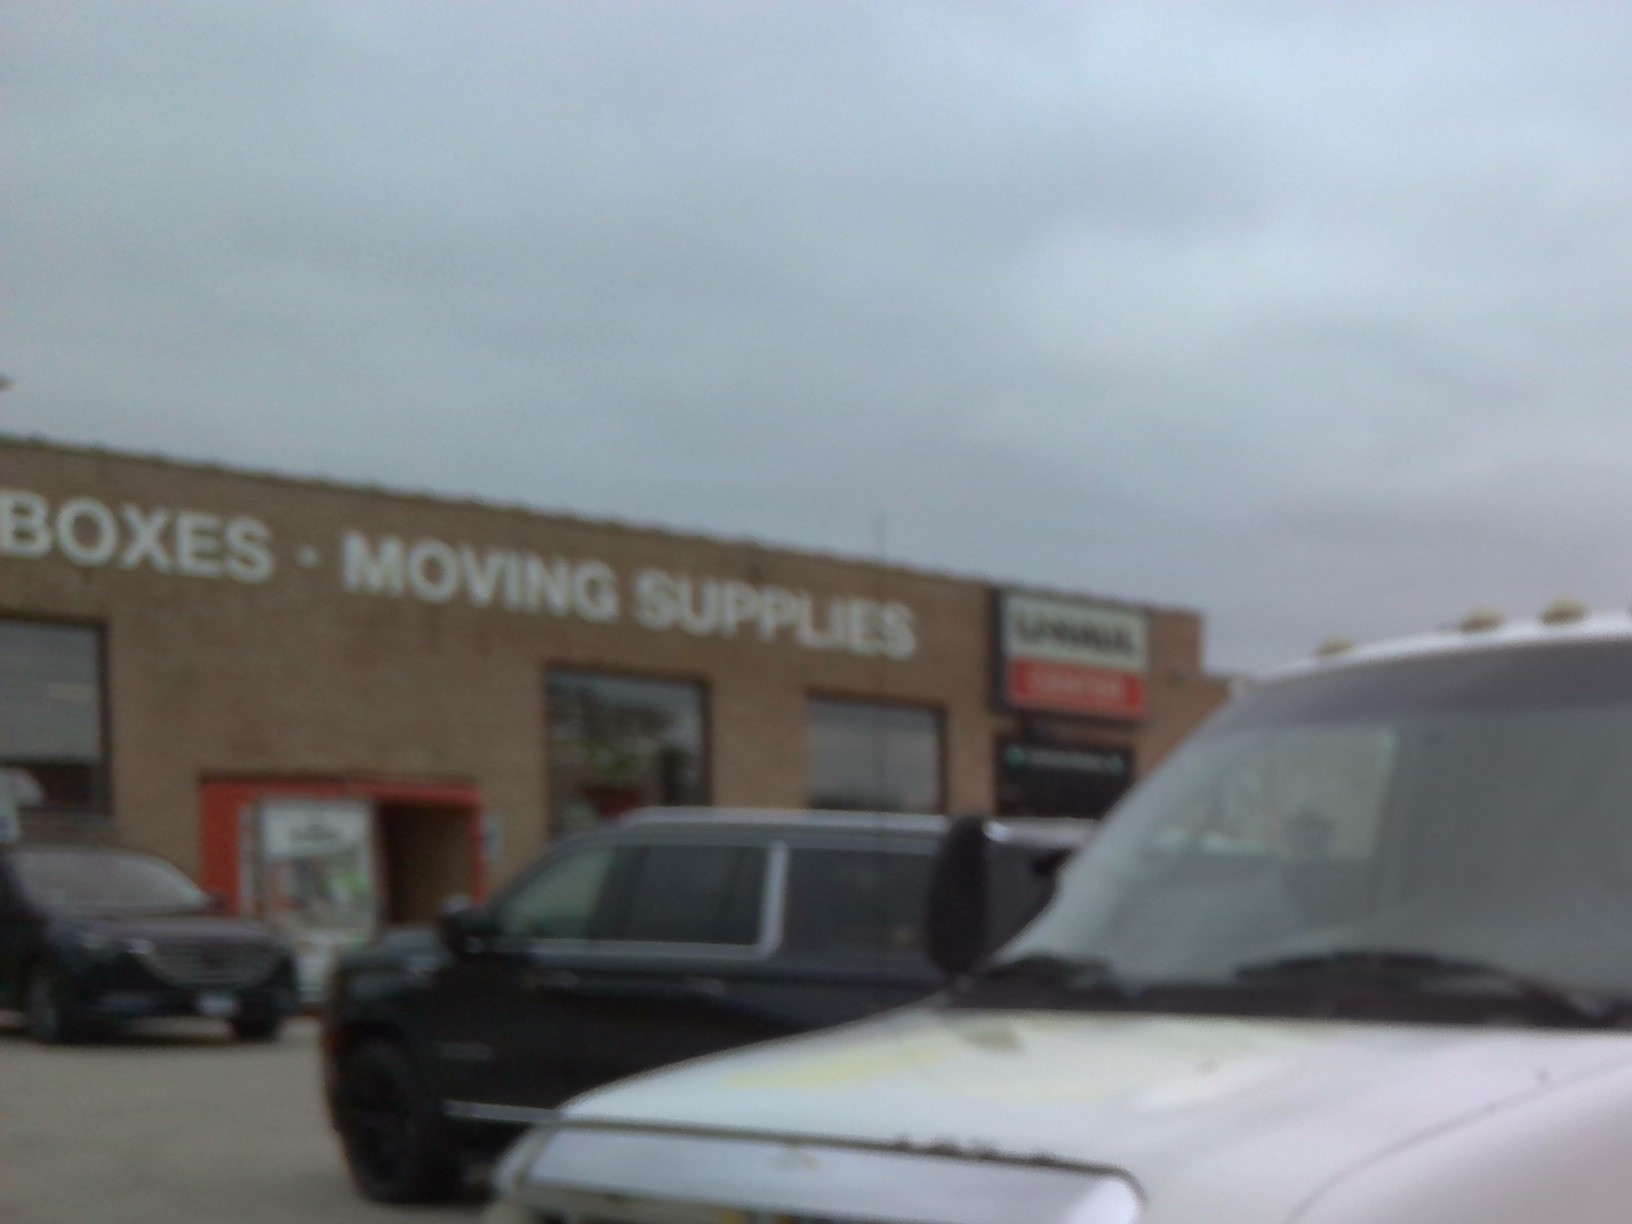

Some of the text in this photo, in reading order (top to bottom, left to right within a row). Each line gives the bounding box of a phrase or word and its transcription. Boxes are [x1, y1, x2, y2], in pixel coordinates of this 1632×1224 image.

[0, 490, 916, 661] BOXES MOVING SUPPLIES
